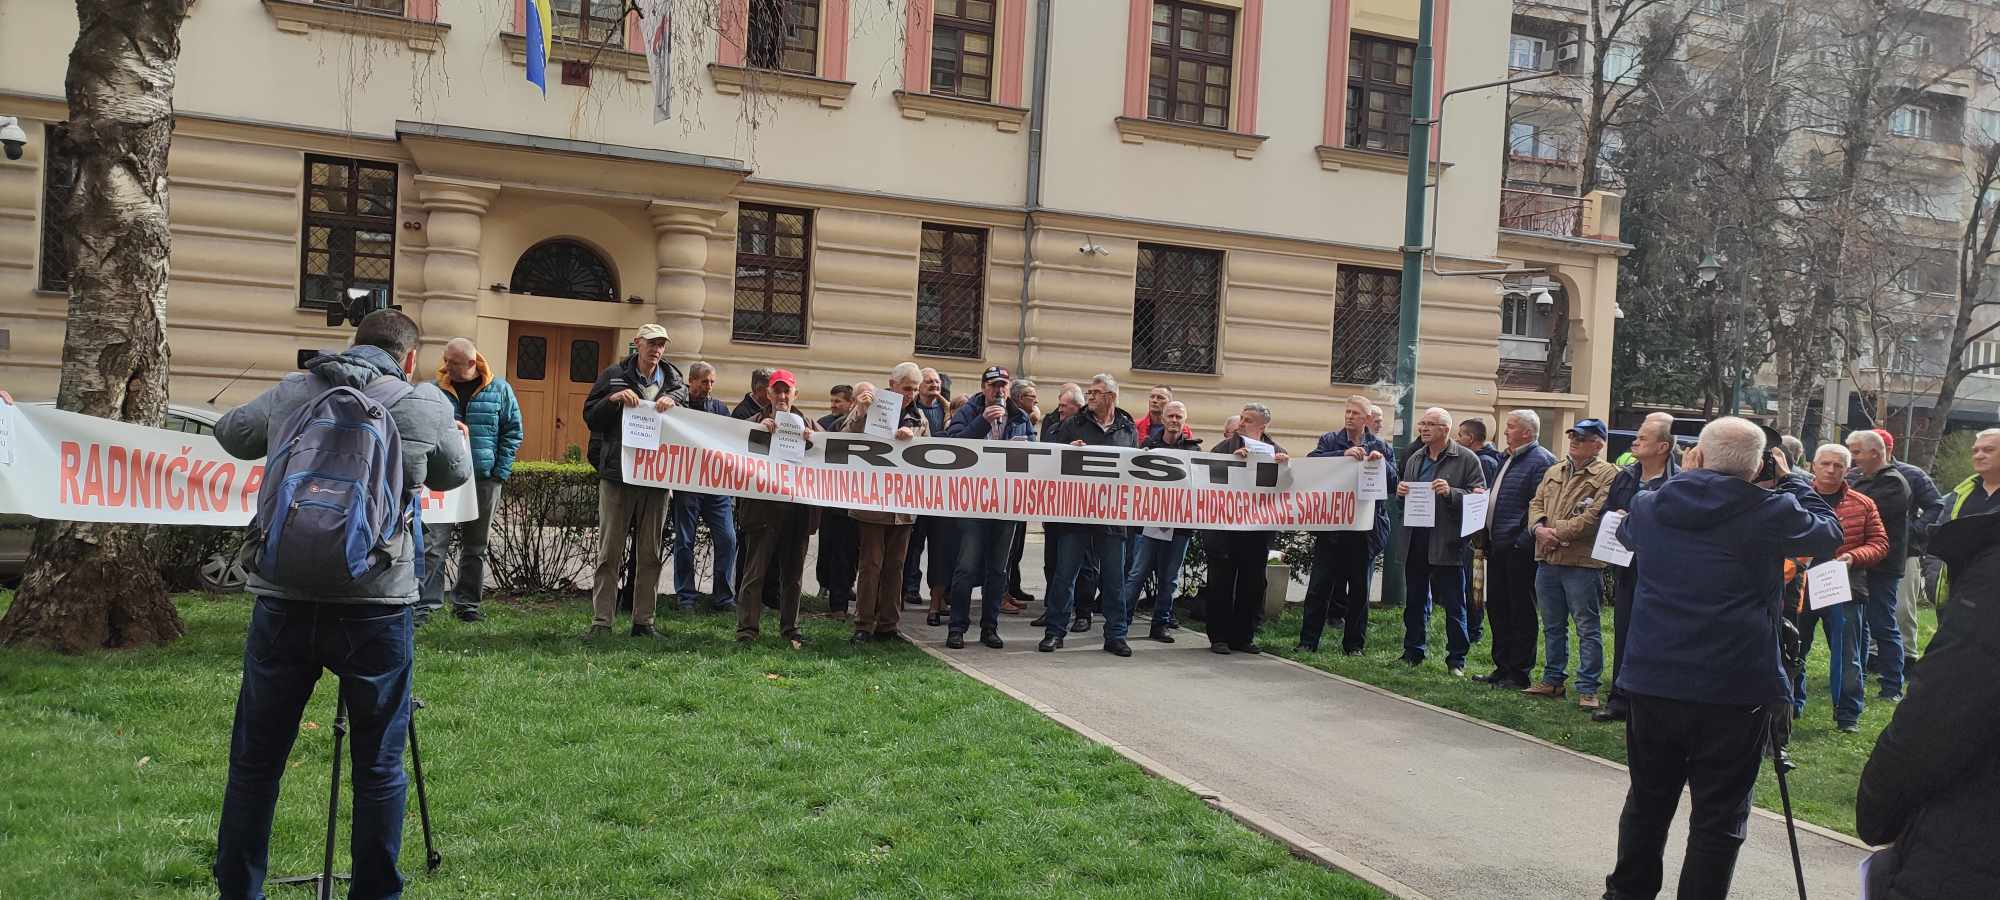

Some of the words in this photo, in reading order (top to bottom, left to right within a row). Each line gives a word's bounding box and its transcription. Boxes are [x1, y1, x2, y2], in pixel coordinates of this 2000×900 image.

[60, 441, 236, 513] RADNIČKO
[633, 443, 697, 485] PROTIV
[950, 476, 999, 514] NOVCA
[1003, 477, 1009, 514] I
[1013, 478, 1128, 520] DISKRIMINACIJE
[1132, 485, 1193, 523] RADNIKA
[1196, 488, 1294, 525] HIDROGRADNJE
[1295, 490, 1356, 526] SARAJEVO
